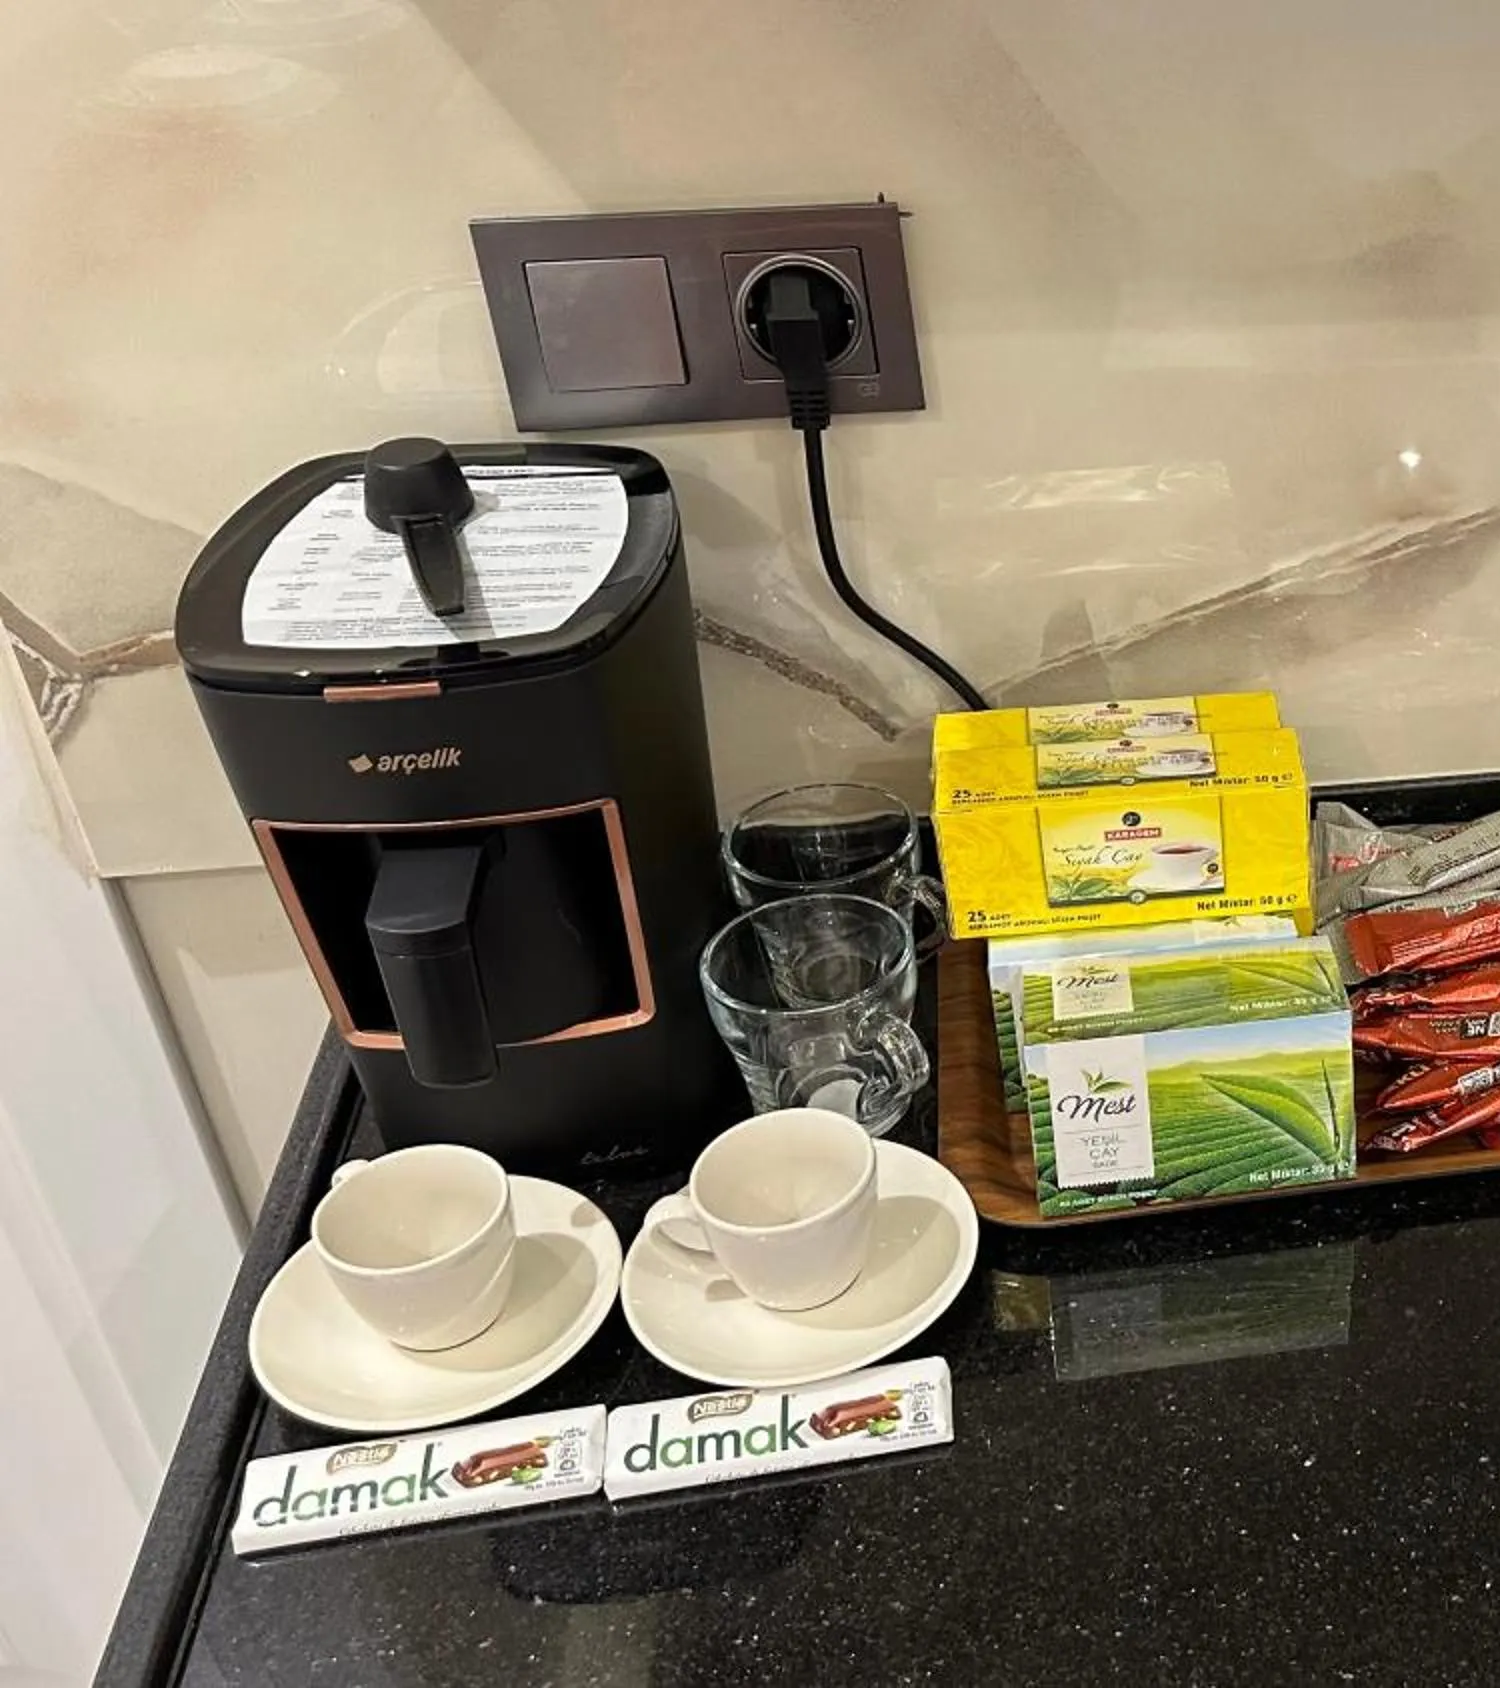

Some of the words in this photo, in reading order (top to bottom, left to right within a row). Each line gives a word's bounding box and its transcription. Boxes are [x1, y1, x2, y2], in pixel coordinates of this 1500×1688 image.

[377, 747, 462, 775] arçelik
[968, 910, 987, 923] 25
[1057, 973, 1119, 989] Mest
[1057, 1094, 1137, 1122] Mest
[624, 1394, 809, 1473] damak
[252, 1443, 449, 1527] damak
